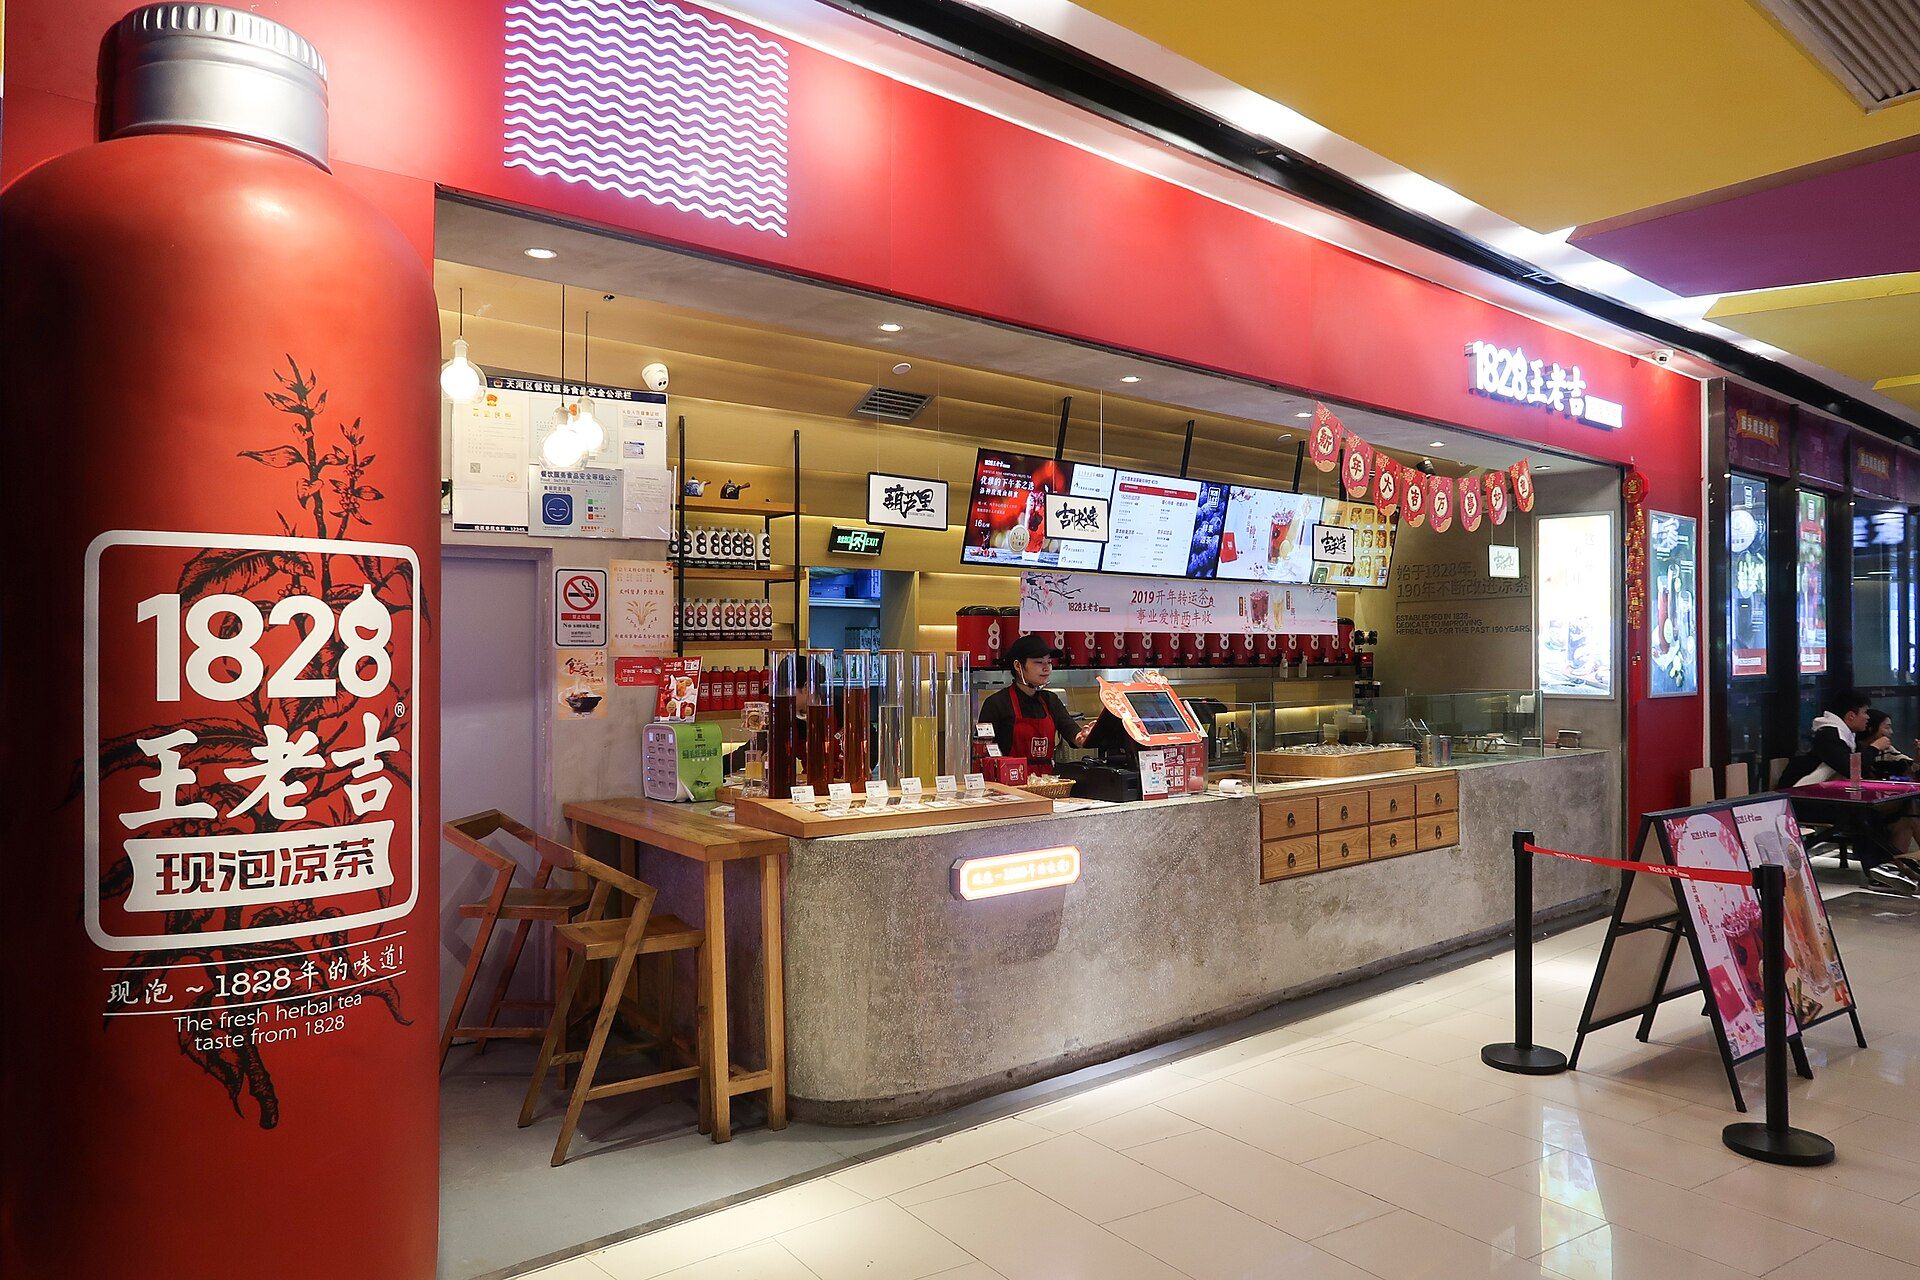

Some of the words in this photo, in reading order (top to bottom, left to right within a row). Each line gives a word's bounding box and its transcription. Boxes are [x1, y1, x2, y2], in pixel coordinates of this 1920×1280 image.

[866, 538, 879, 547] EXIT
[1137, 607, 1212, 626] 事业爱情两丰收
[1424, 627, 1440, 635] TEA
[1471, 626, 1489, 634] PAST
[136, 584, 392, 702] 1828
[119, 711, 400, 830] 王老吉
[155, 838, 375, 896] 现泡凉茶
[173, 1015, 212, 1033] The
[219, 1008, 268, 1029] fresh
[276, 996, 333, 1019] herbal
[337, 993, 363, 1008] tea
[194, 1031, 244, 1051] taste
[250, 1025, 297, 1044] from
[304, 1015, 345, 1036] 1828
